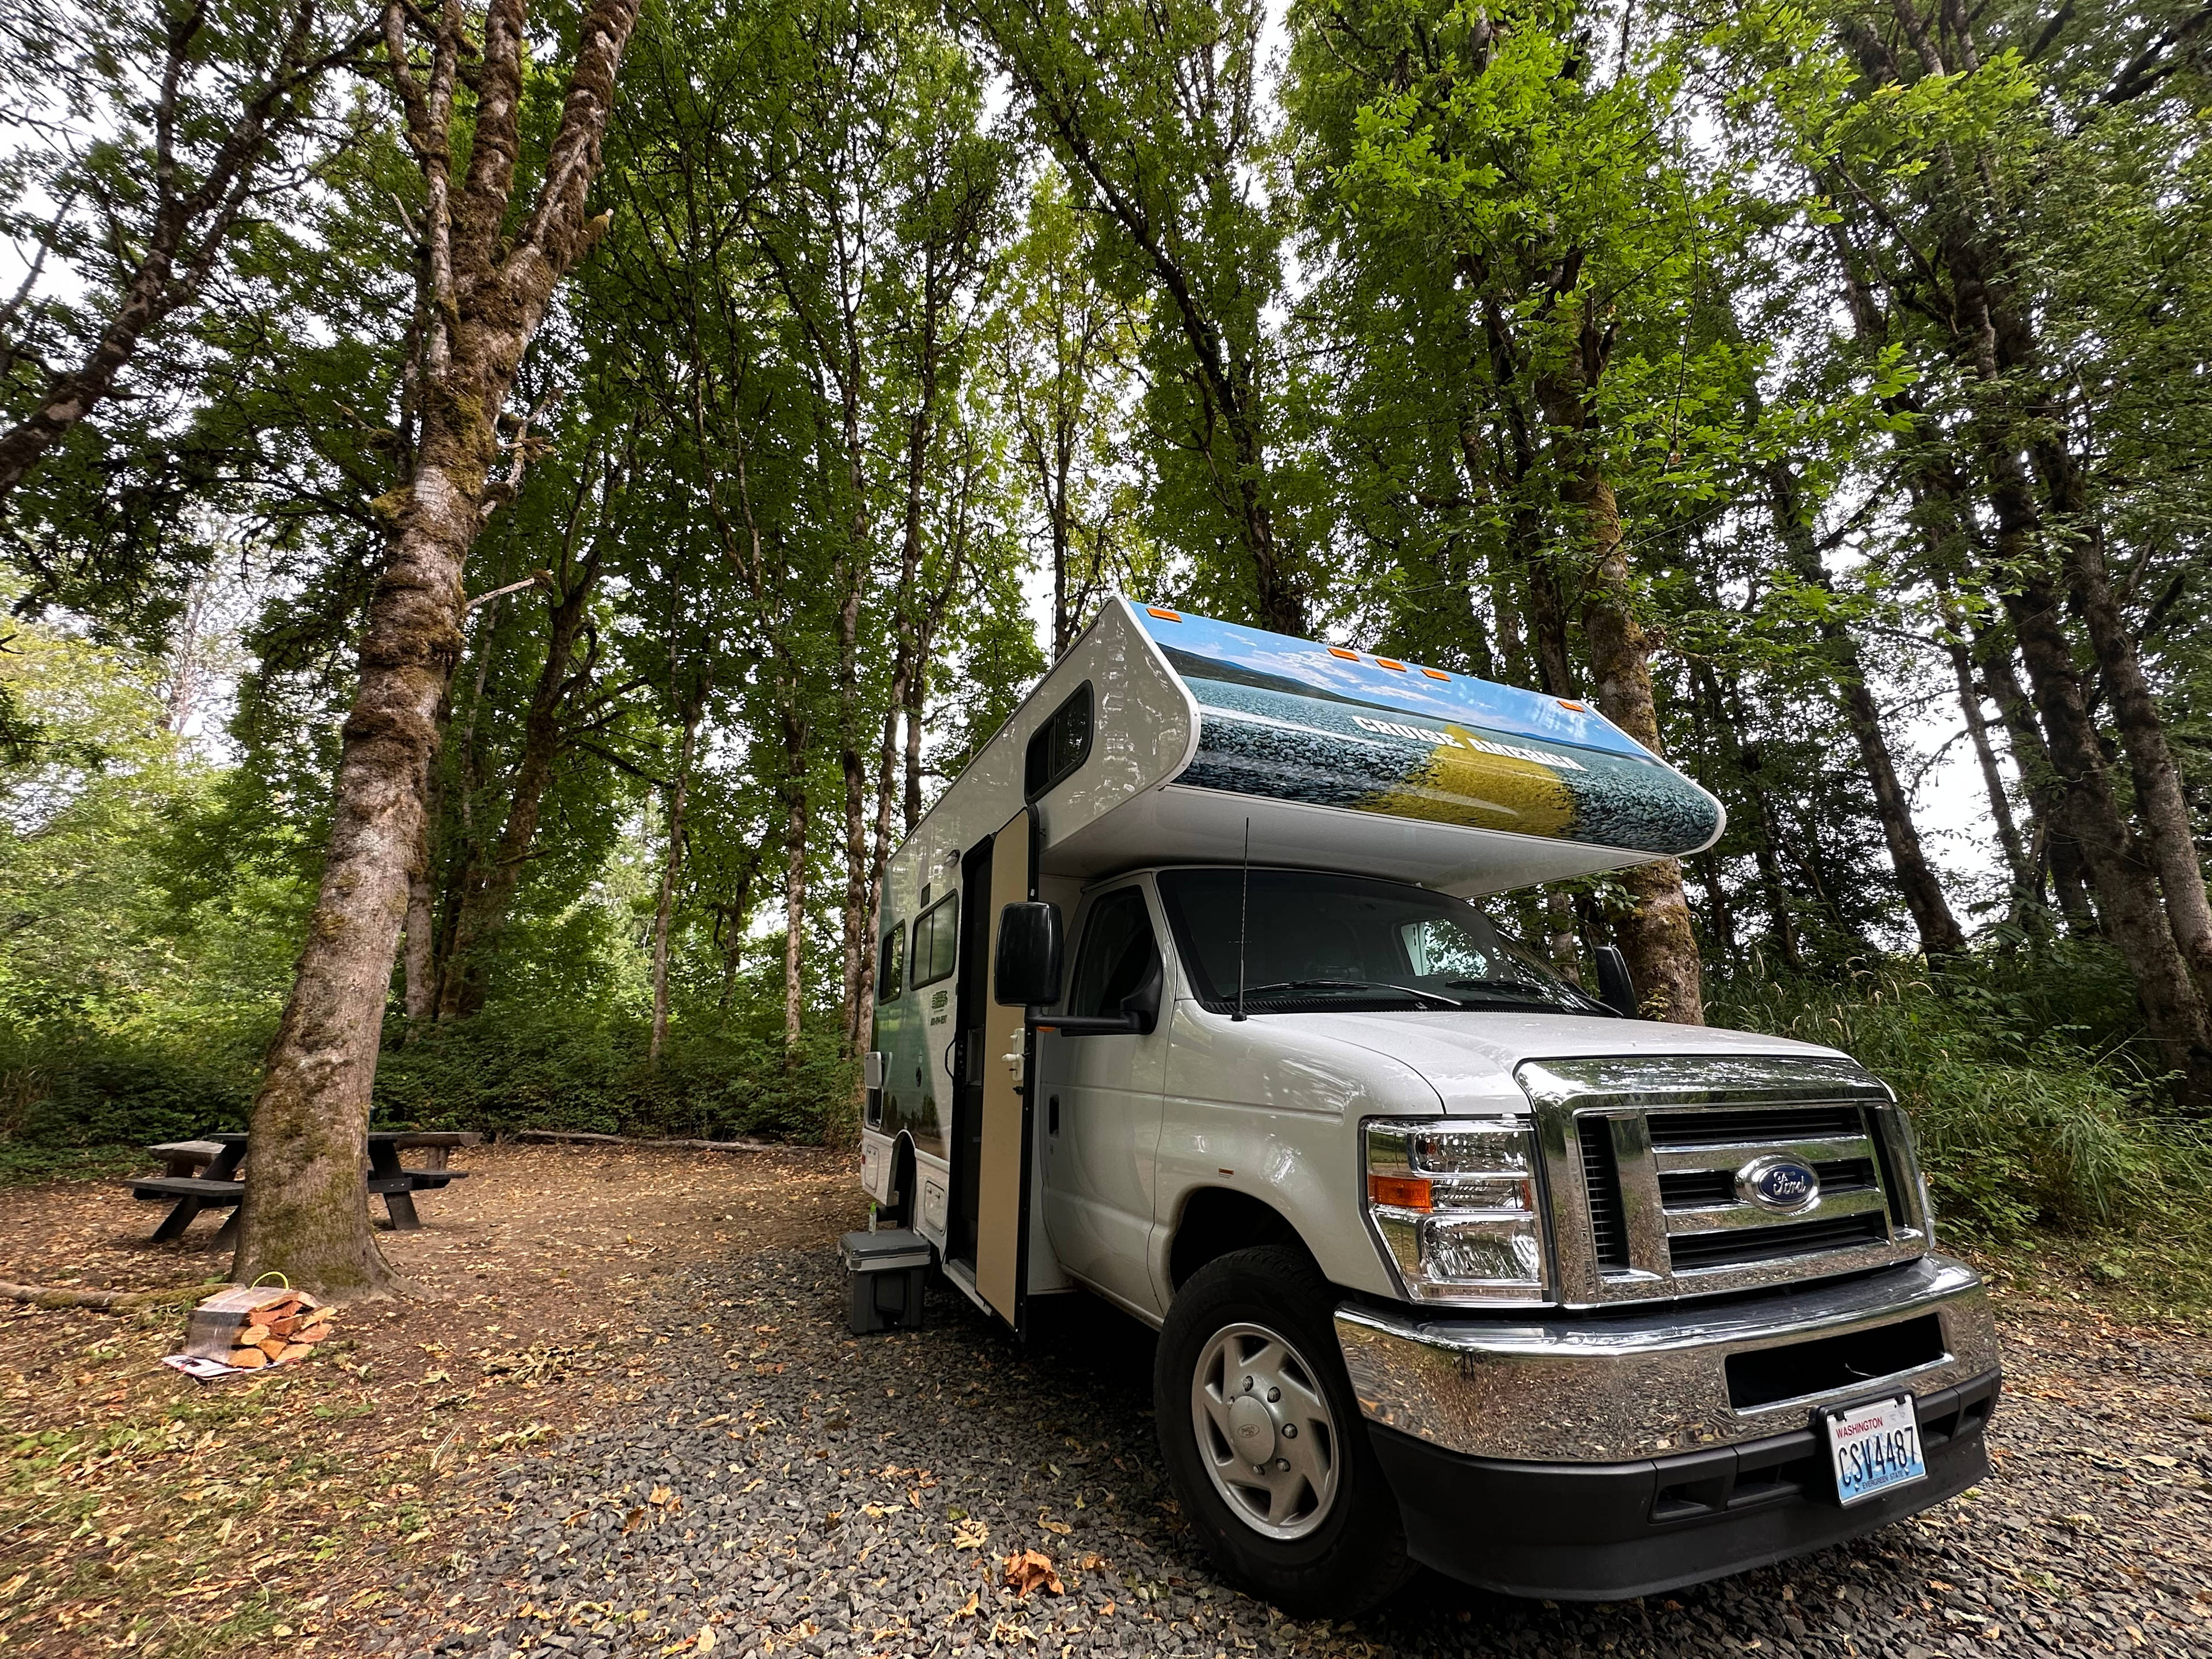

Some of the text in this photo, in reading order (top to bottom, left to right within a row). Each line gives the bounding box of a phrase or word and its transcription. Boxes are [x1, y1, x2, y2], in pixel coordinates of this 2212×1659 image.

[1352, 715, 1589, 771] CRUISE AMERICA
[1773, 1171, 1806, 1195] Ford
[1836, 1416, 1883, 1439] WASHINGTON
[1839, 1426, 1915, 1487] CSV4487
[1862, 1469, 1904, 1490] EVERGREEN STATE
